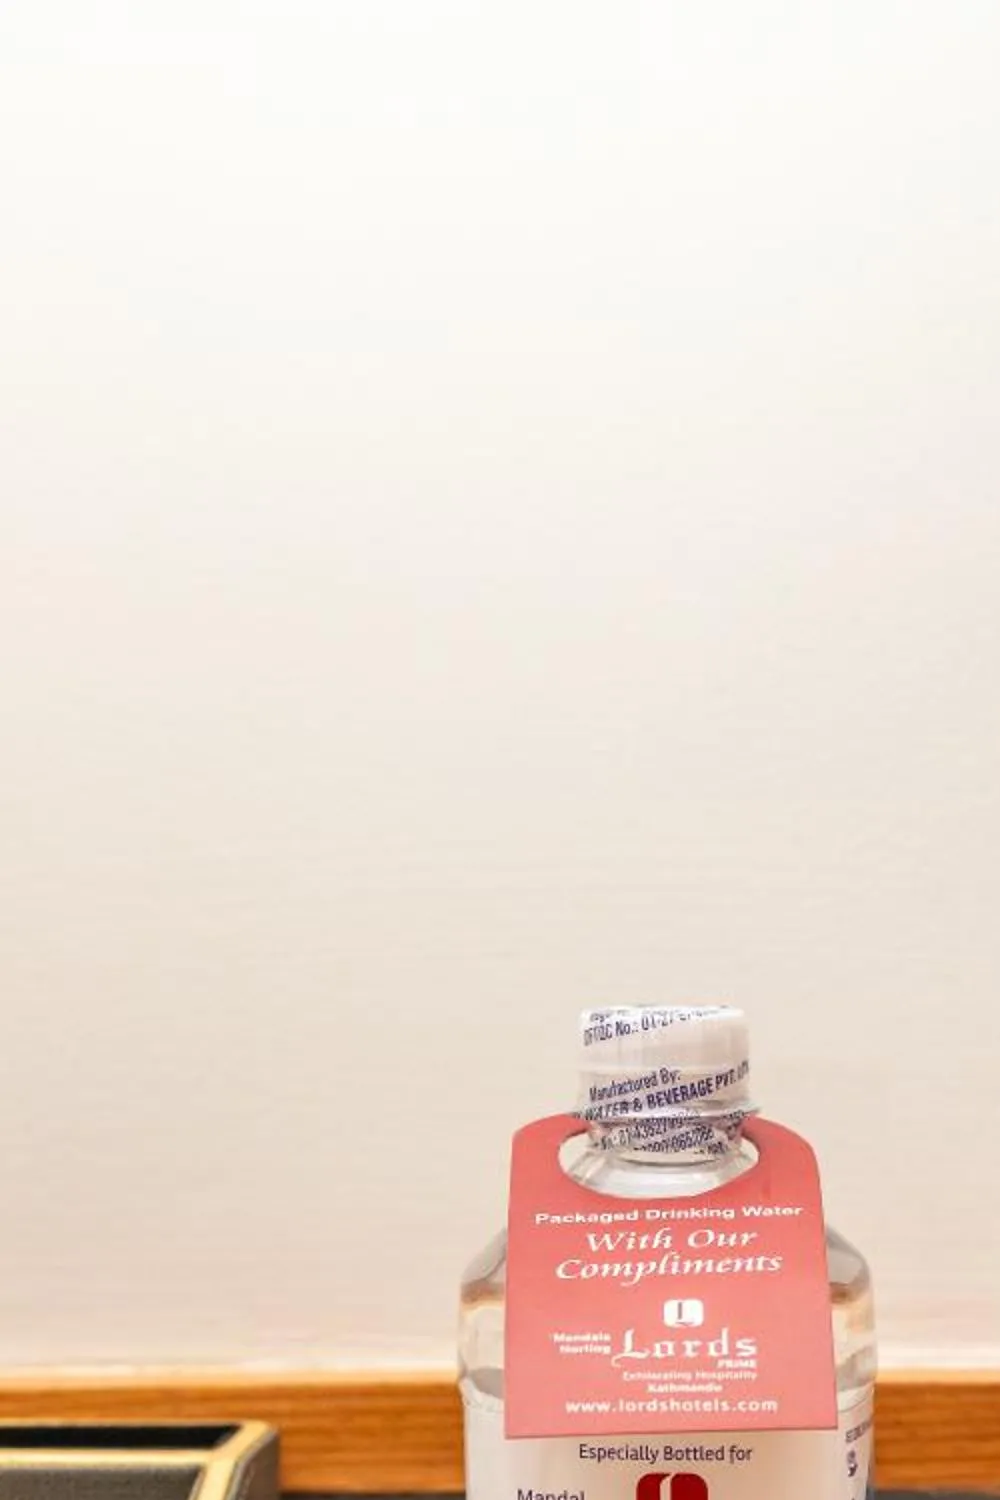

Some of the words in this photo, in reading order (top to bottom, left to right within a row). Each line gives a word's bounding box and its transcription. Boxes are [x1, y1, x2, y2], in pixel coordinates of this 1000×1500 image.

[646, 1077, 713, 1110] BEVERAGE
[535, 1210, 639, 1225] Packaged
[645, 1206, 735, 1221] Drinking
[742, 1205, 804, 1217] Water
[586, 1226, 673, 1252] With
[687, 1228, 758, 1249] Our
[555, 1250, 784, 1287] Compliments
[611, 1327, 758, 1369] Lords
[565, 1398, 779, 1415] www.lordshotels.com
[579, 1443, 660, 1465] Especially
[663, 1445, 726, 1462] Bottled
[729, 1446, 754, 1463] for
